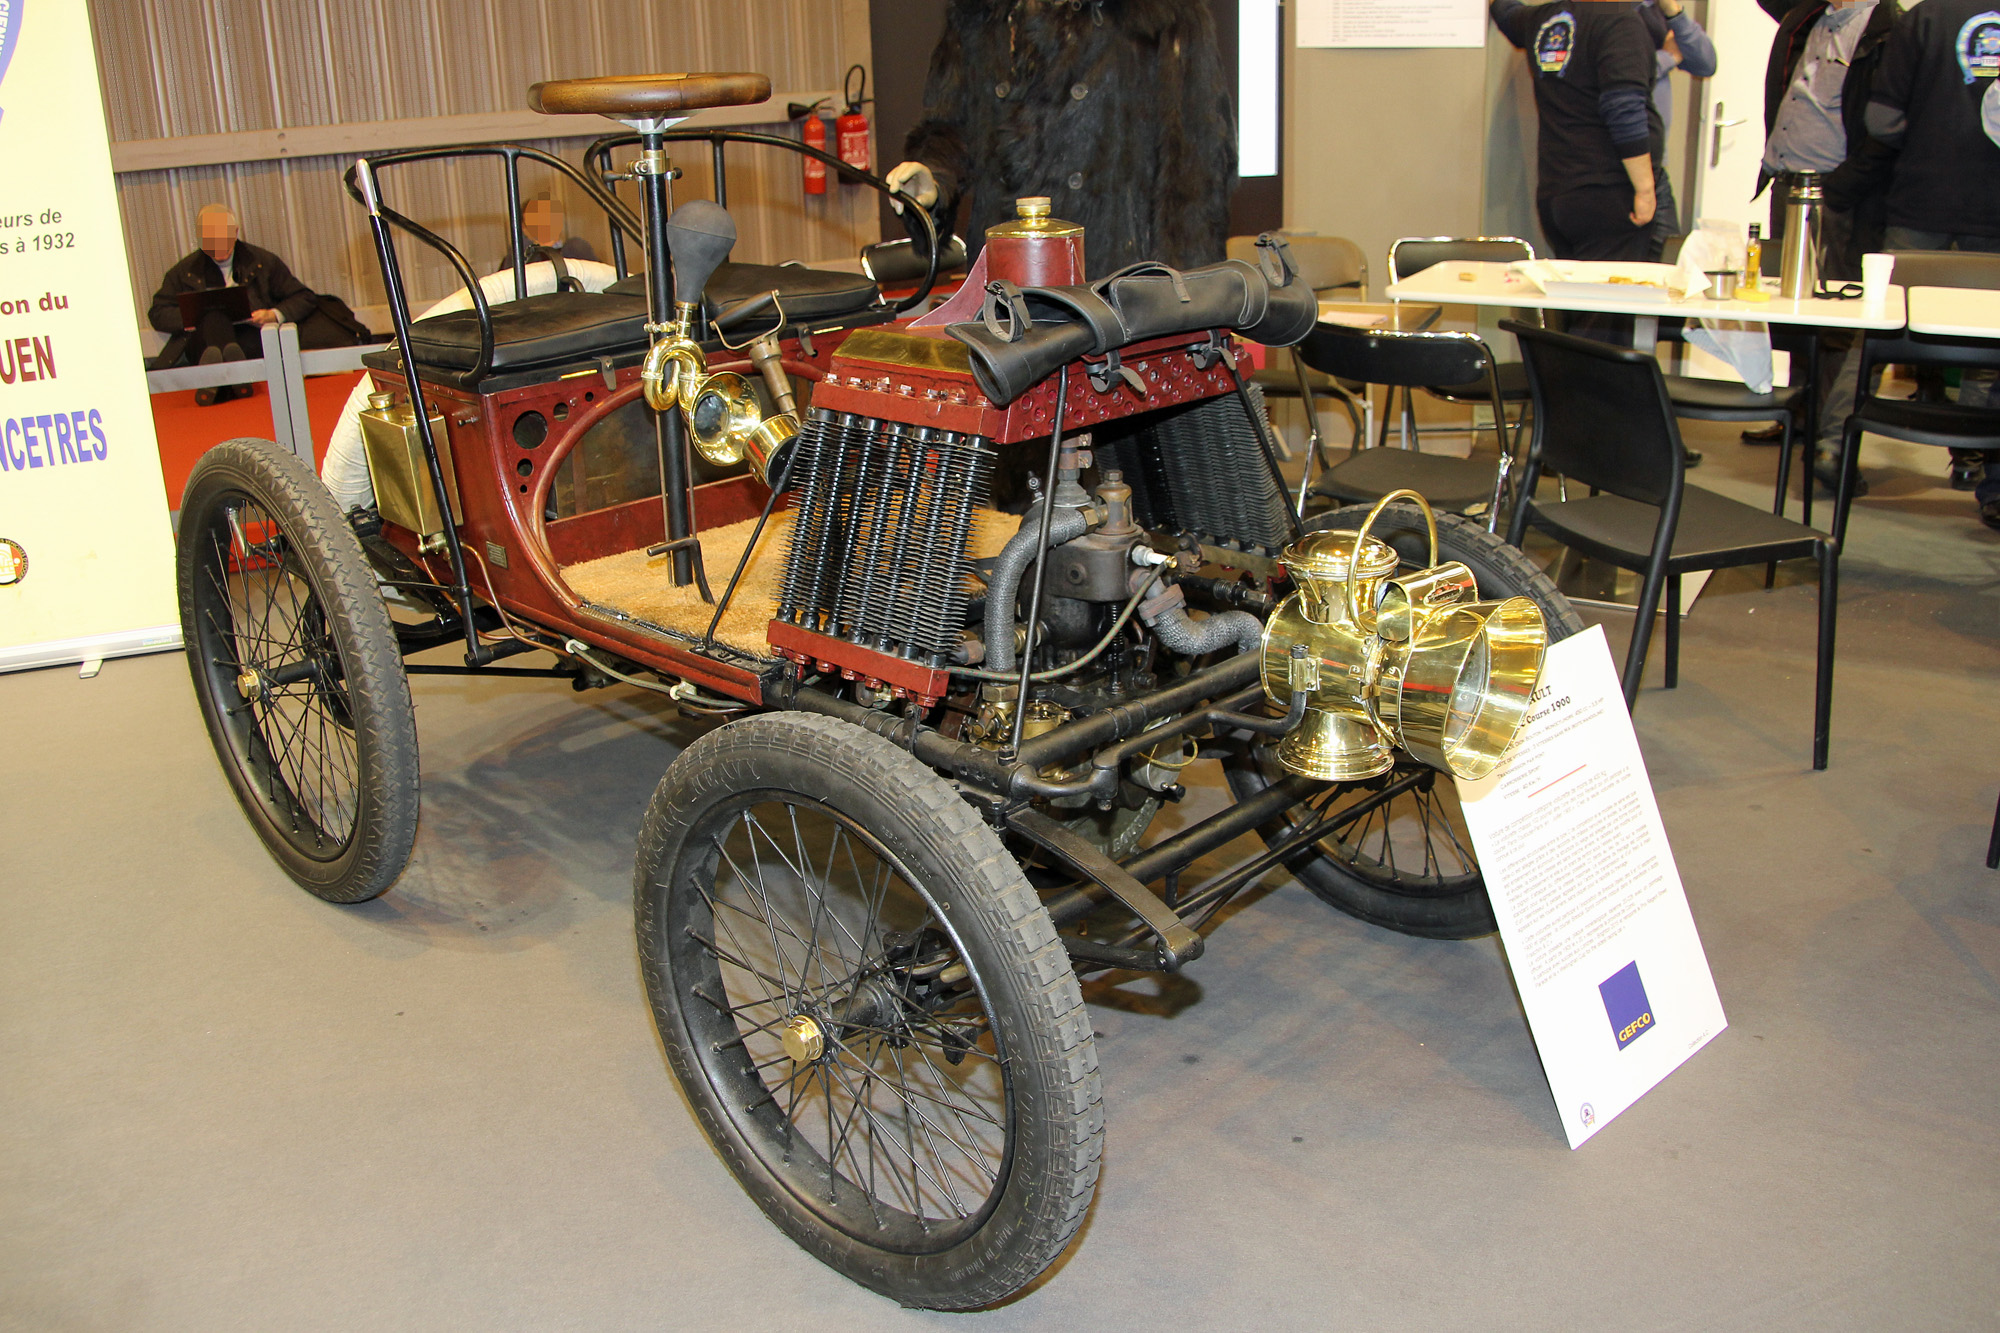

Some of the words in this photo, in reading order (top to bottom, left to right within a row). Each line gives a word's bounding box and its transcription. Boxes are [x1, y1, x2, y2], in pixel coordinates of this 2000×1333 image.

[0, 212, 33, 228] urs
[40, 208, 62, 224] de
[16, 237, 26, 252] à
[32, 232, 75, 251] 1932
[38, 292, 69, 312] du
[1529, 685, 1552, 704] AULT
[1526, 708, 1550, 724] Course
[1551, 696, 1572, 712] 1900
[1618, 1012, 1650, 1042] GEFCO
